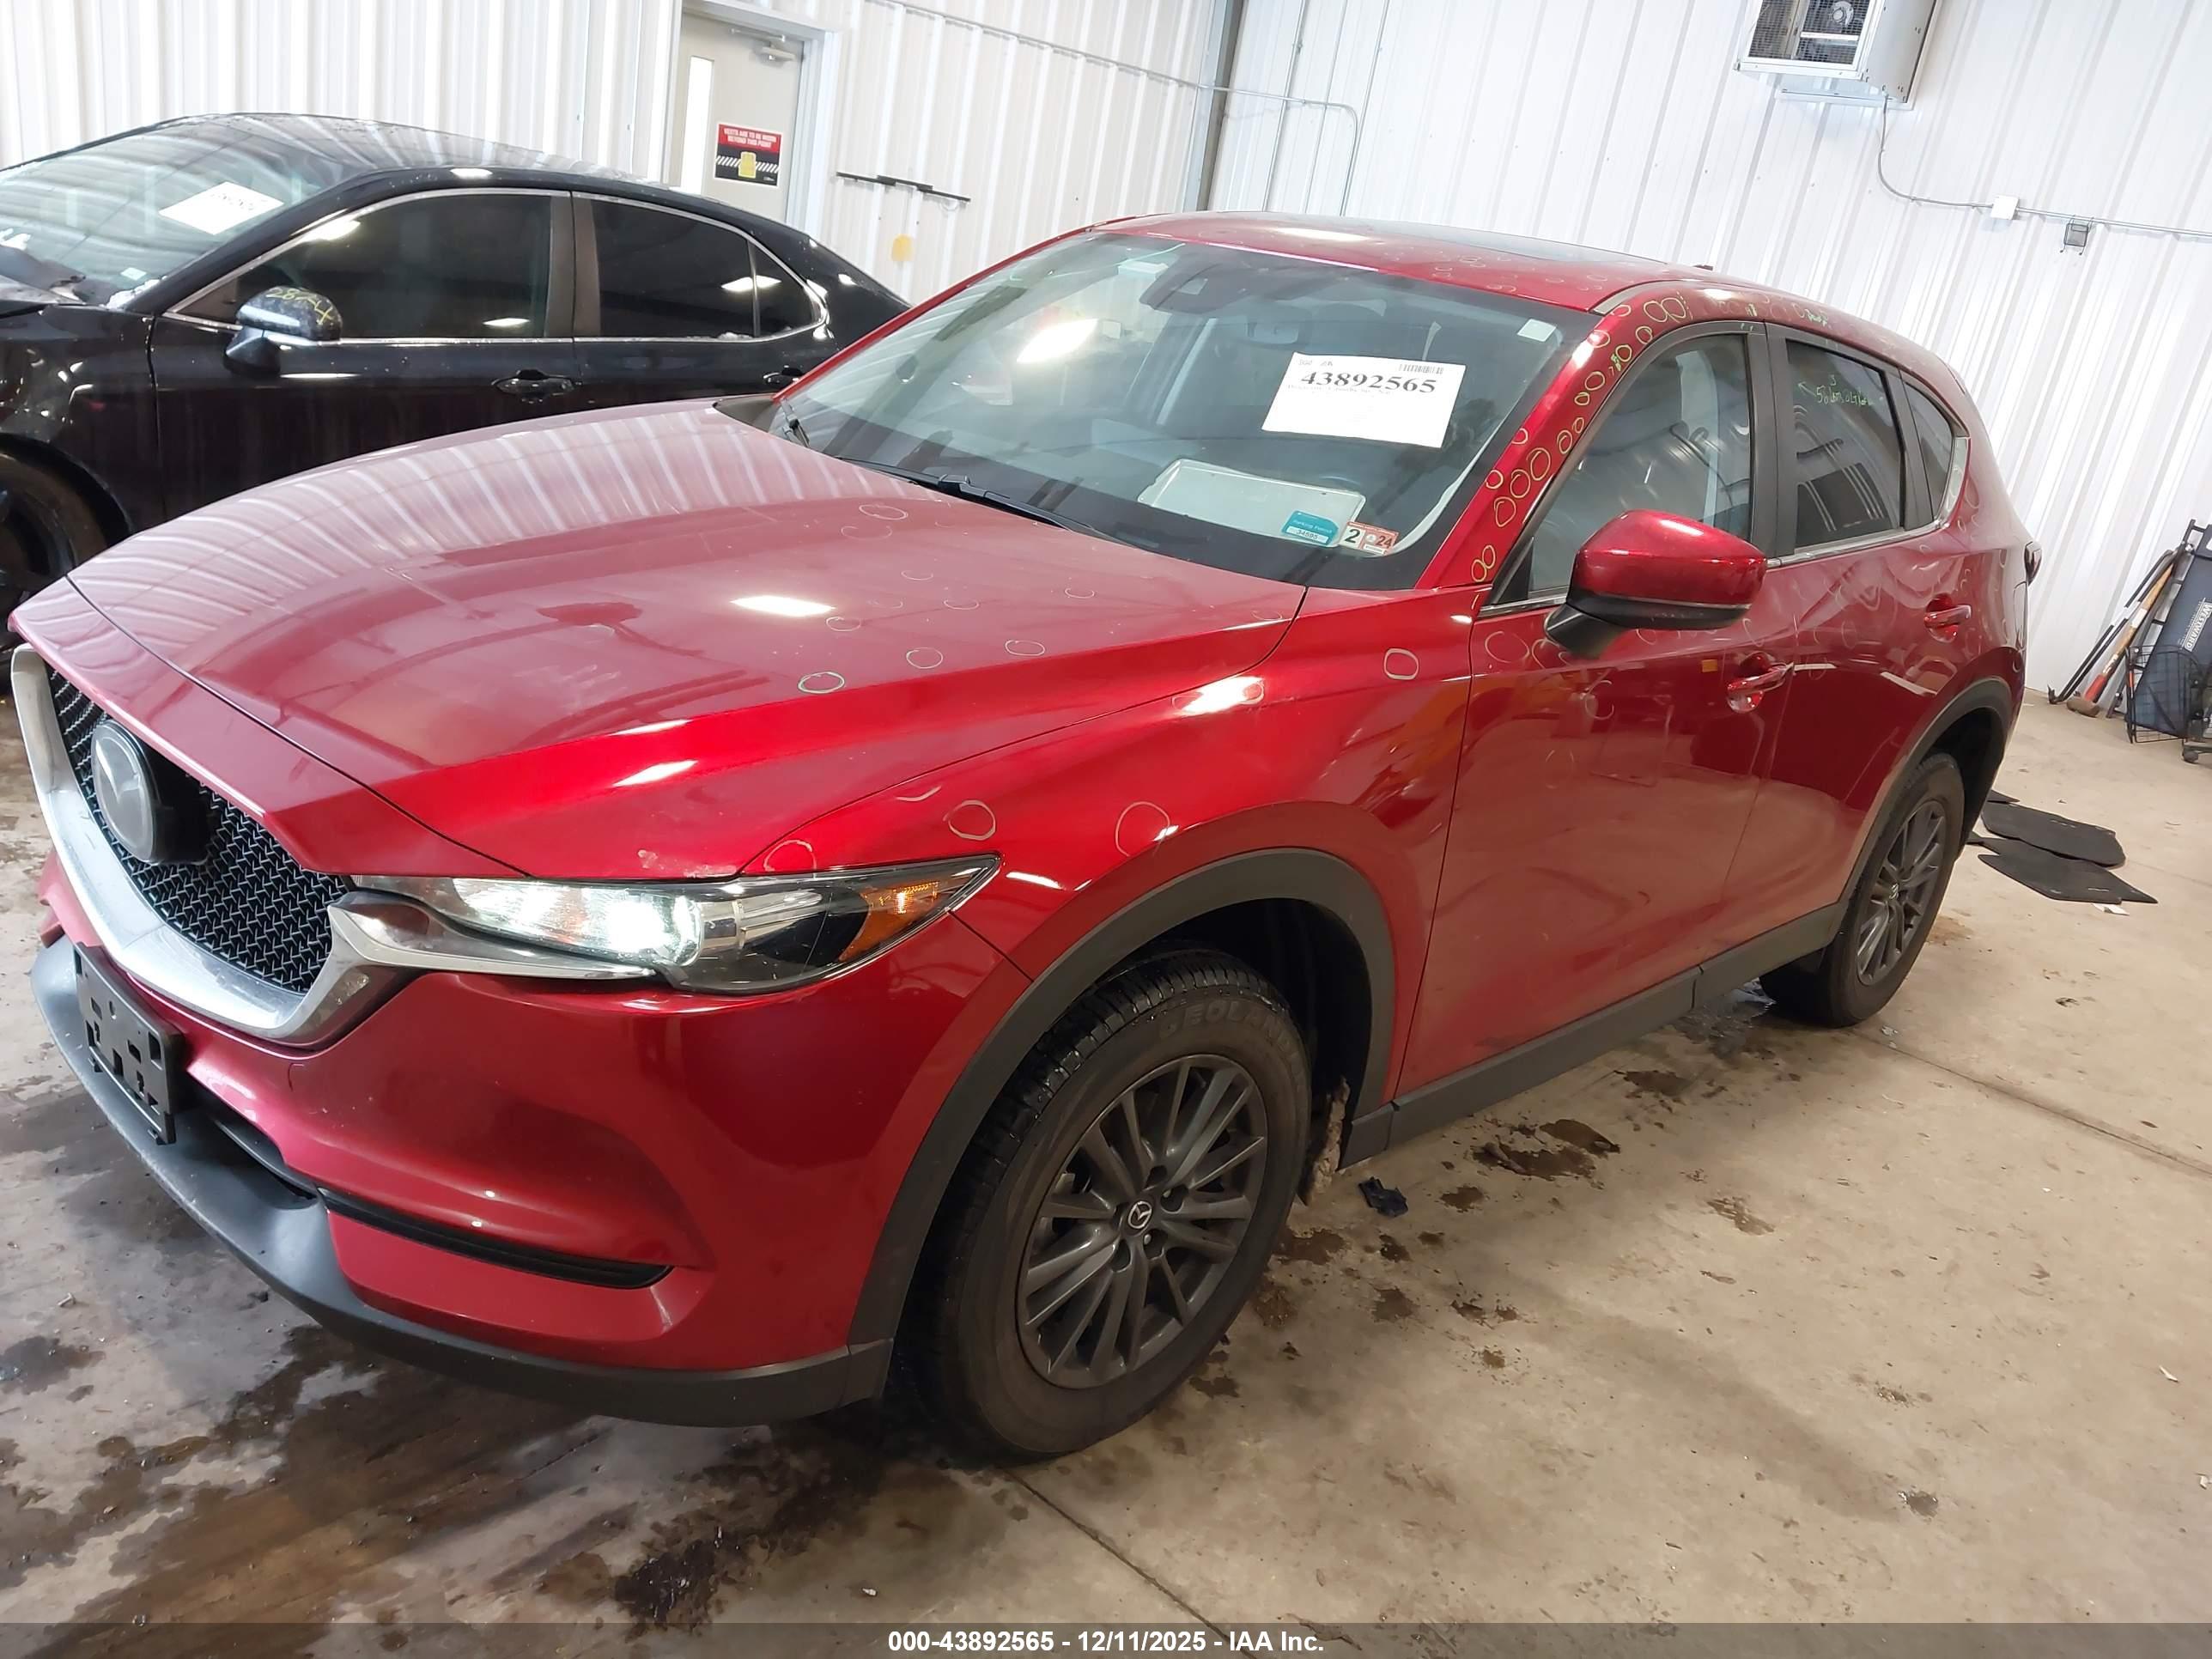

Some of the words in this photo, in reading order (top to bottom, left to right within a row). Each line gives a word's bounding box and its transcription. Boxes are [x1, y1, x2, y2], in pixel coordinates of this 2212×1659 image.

[1301, 371, 1437, 393] 43892565
[1345, 528, 1361, 544] 2
[1376, 535, 1392, 549] 24
[2185, 603, 2212, 649] WESTWARD
